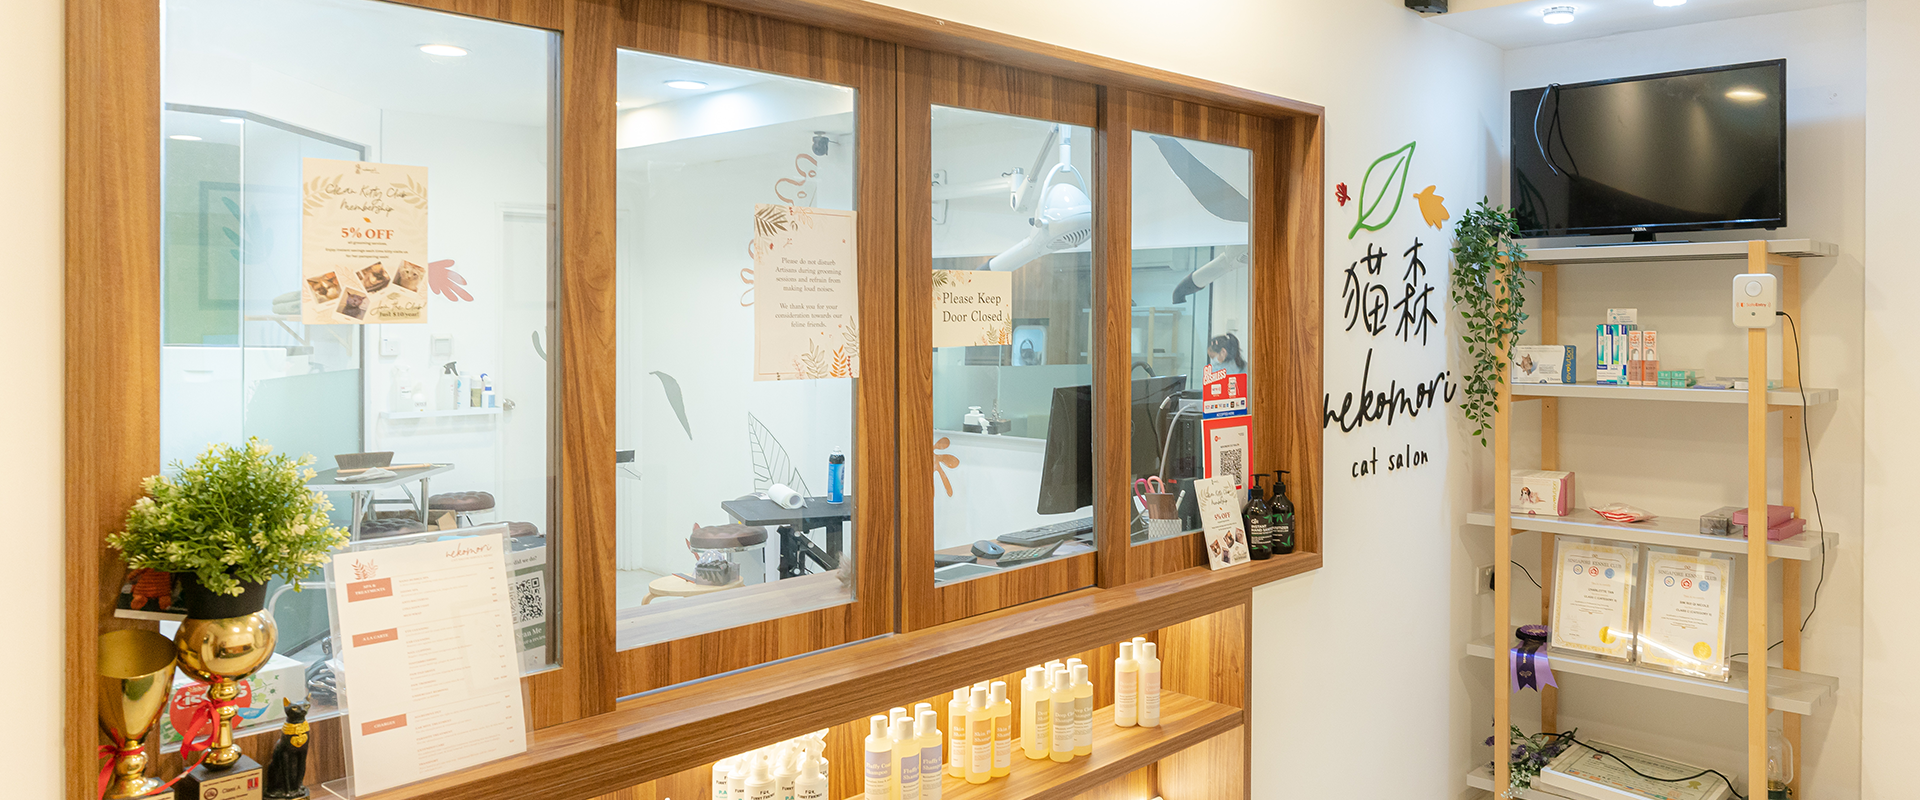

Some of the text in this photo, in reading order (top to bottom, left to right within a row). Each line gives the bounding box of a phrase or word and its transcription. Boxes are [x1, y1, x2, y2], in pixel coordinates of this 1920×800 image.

[341, 227, 394, 240] 5% OFF
[798, 267, 816, 275] during
[817, 268, 841, 276] grooming
[942, 292, 1002, 306] Please Keep
[1342, 237, 1438, 346] 猫森
[943, 310, 1002, 322] Door Closed
[1565, 346, 1573, 383] revolution
[1324, 348, 1456, 433] nekomori
[1352, 444, 1429, 478] cat salon
[445, 543, 492, 559] nekomori
[866, 762, 880, 770] Fluffy
